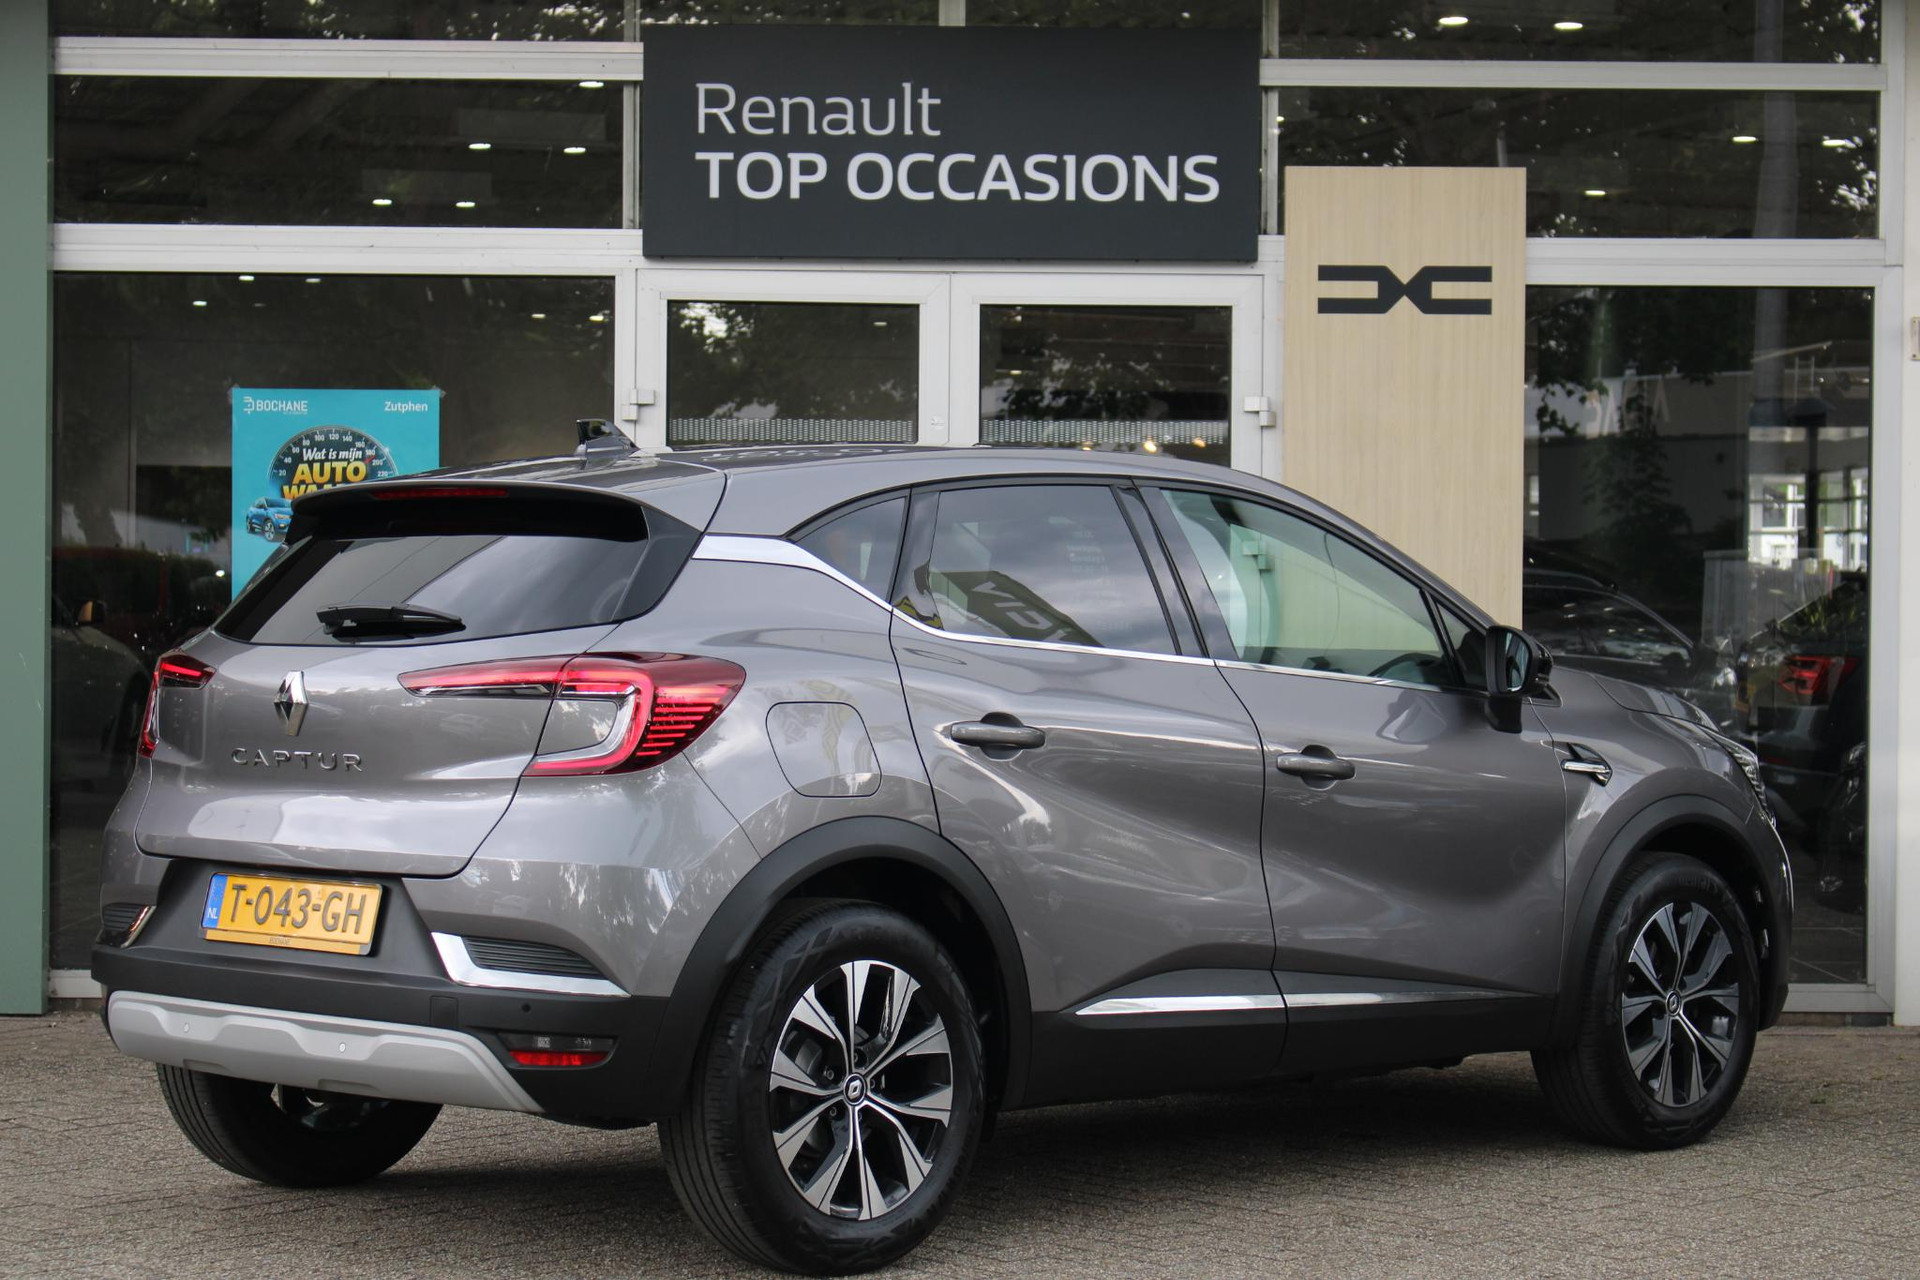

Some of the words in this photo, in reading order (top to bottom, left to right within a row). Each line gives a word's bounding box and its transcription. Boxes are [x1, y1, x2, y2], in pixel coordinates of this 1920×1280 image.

[695, 82, 941, 136] Renault
[695, 151, 828, 200] TOP
[847, 152, 1220, 202] OCCASIONS
[256, 400, 308, 412] BOCHANE
[384, 401, 428, 414] Zutphen
[303, 448, 326, 461] Wat
[328, 448, 337, 460] is
[339, 448, 362, 462] mijn
[292, 461, 367, 484] AUTO
[231, 747, 363, 773] CAPTUR
[207, 907, 218, 919] NL
[231, 884, 367, 935] T-043-GH
